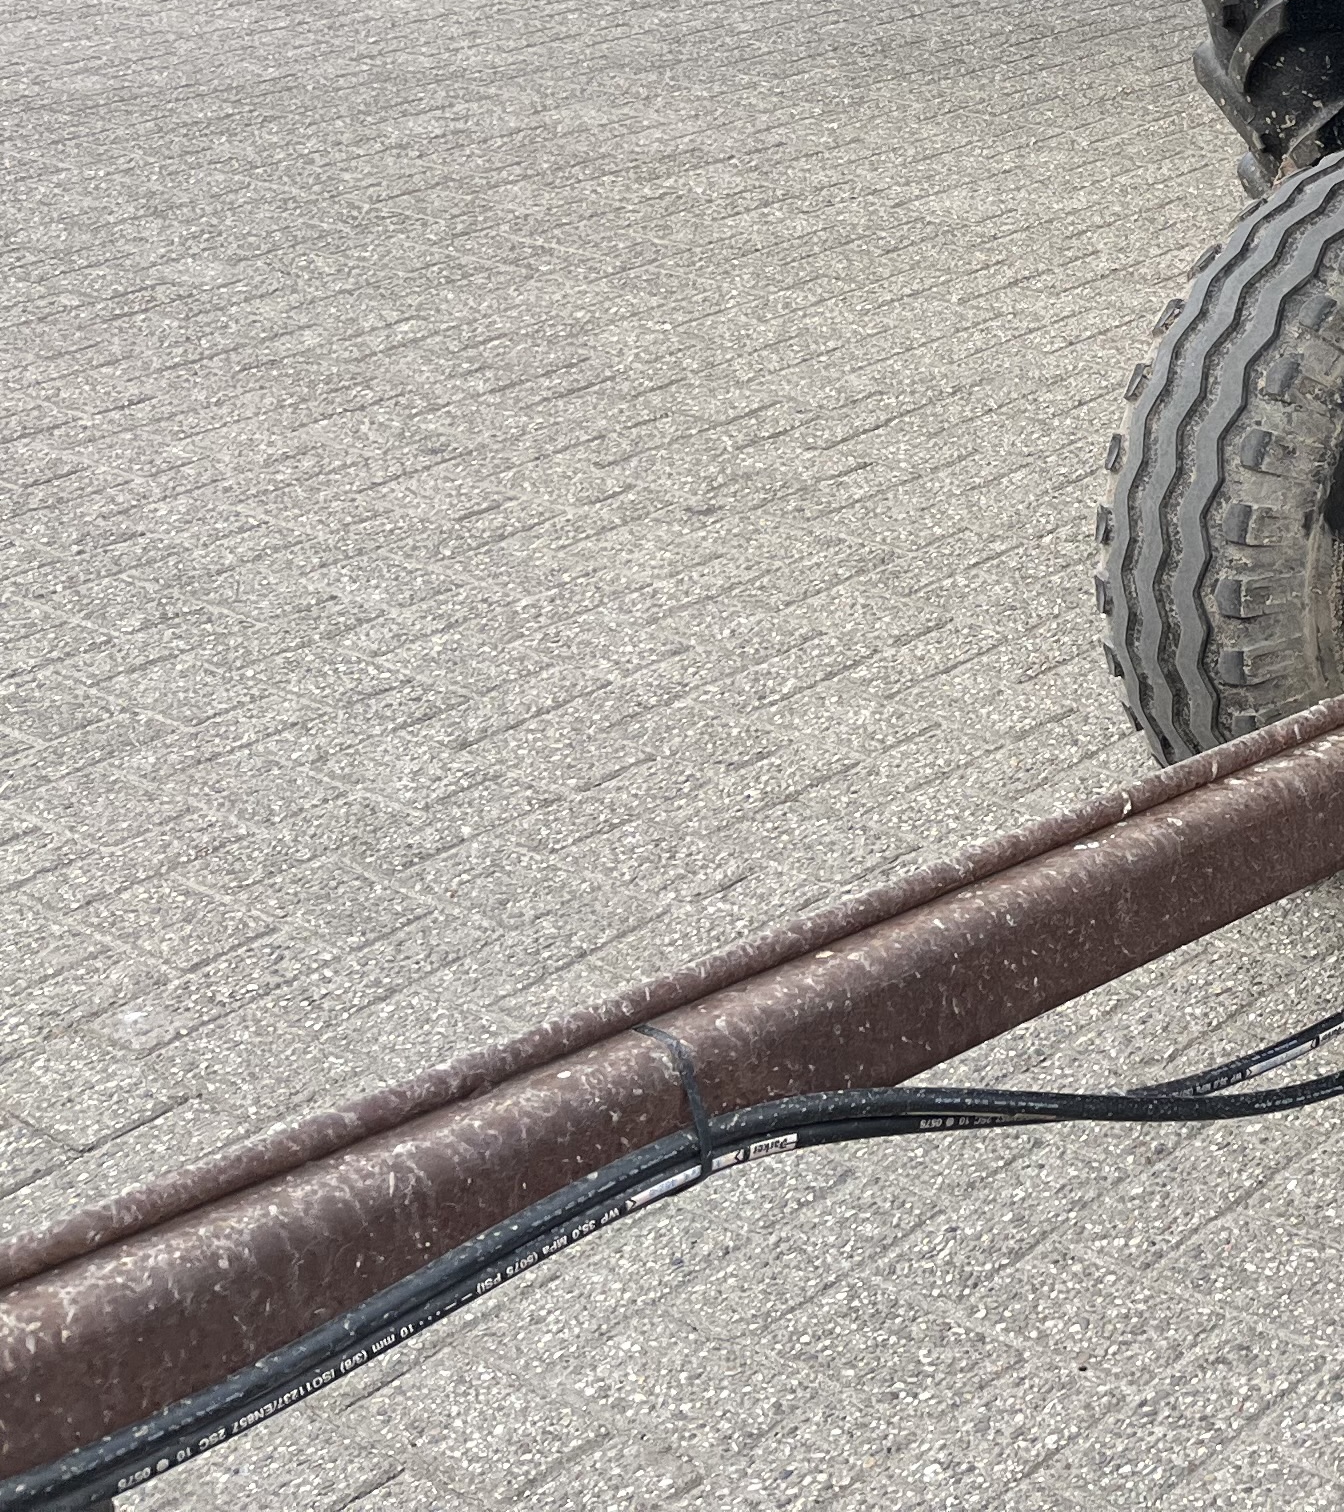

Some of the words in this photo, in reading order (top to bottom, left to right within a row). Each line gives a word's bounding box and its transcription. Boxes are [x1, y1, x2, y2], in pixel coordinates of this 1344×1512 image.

[752, 1137, 797, 1155] Parker
[601, 1207, 621, 1225] WP
[572, 1219, 597, 1238] 35,0
[541, 1235, 568, 1255] MPa
[505, 1251, 540, 1277] (5075
[476, 1272, 503, 1294] PSI)
[400, 1323, 415, 1338] 10
[371, 1333, 396, 1352] mm
[198, 1427, 227, 1451] 2SC
[176, 1445, 192, 1462] 10
